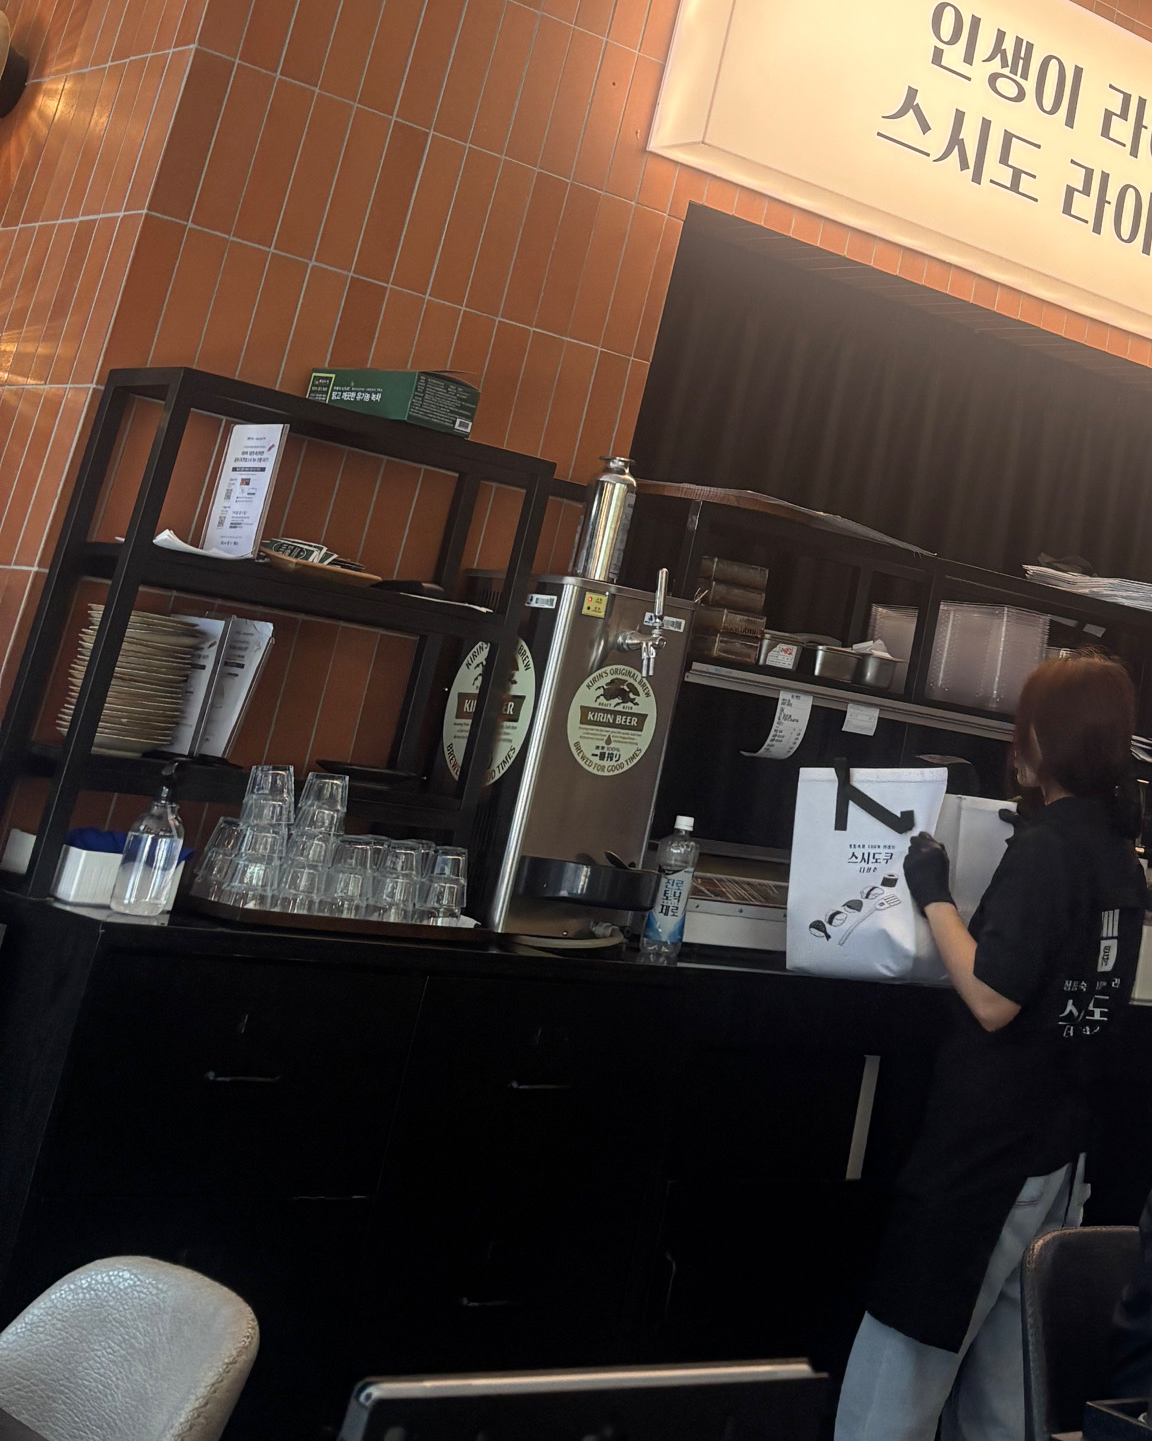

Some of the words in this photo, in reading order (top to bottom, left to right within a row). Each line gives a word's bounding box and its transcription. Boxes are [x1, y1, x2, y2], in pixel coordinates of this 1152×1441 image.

[930, 1, 1082, 129] 인생이
[876, 84, 1043, 203] 스시도
[518, 644, 532, 671] BREW
[585, 670, 609, 690] KIRIN'S
[609, 667, 638, 682] ORIGINAL
[637, 676, 652, 698] BREW
[587, 711, 614, 724] KIRIN
[615, 714, 638, 726] BEER
[497, 745, 516, 774] TIMES
[573, 740, 594, 768] BREWED
[593, 762, 606, 773] FOR
[606, 761, 625, 773] GOOD
[624, 747, 643, 766] TIMES
[847, 851, 894, 864] 스시도쿠
[663, 889, 682, 904] 토닉
[665, 877, 684, 891] 진로
[658, 904, 679, 917] 제로
